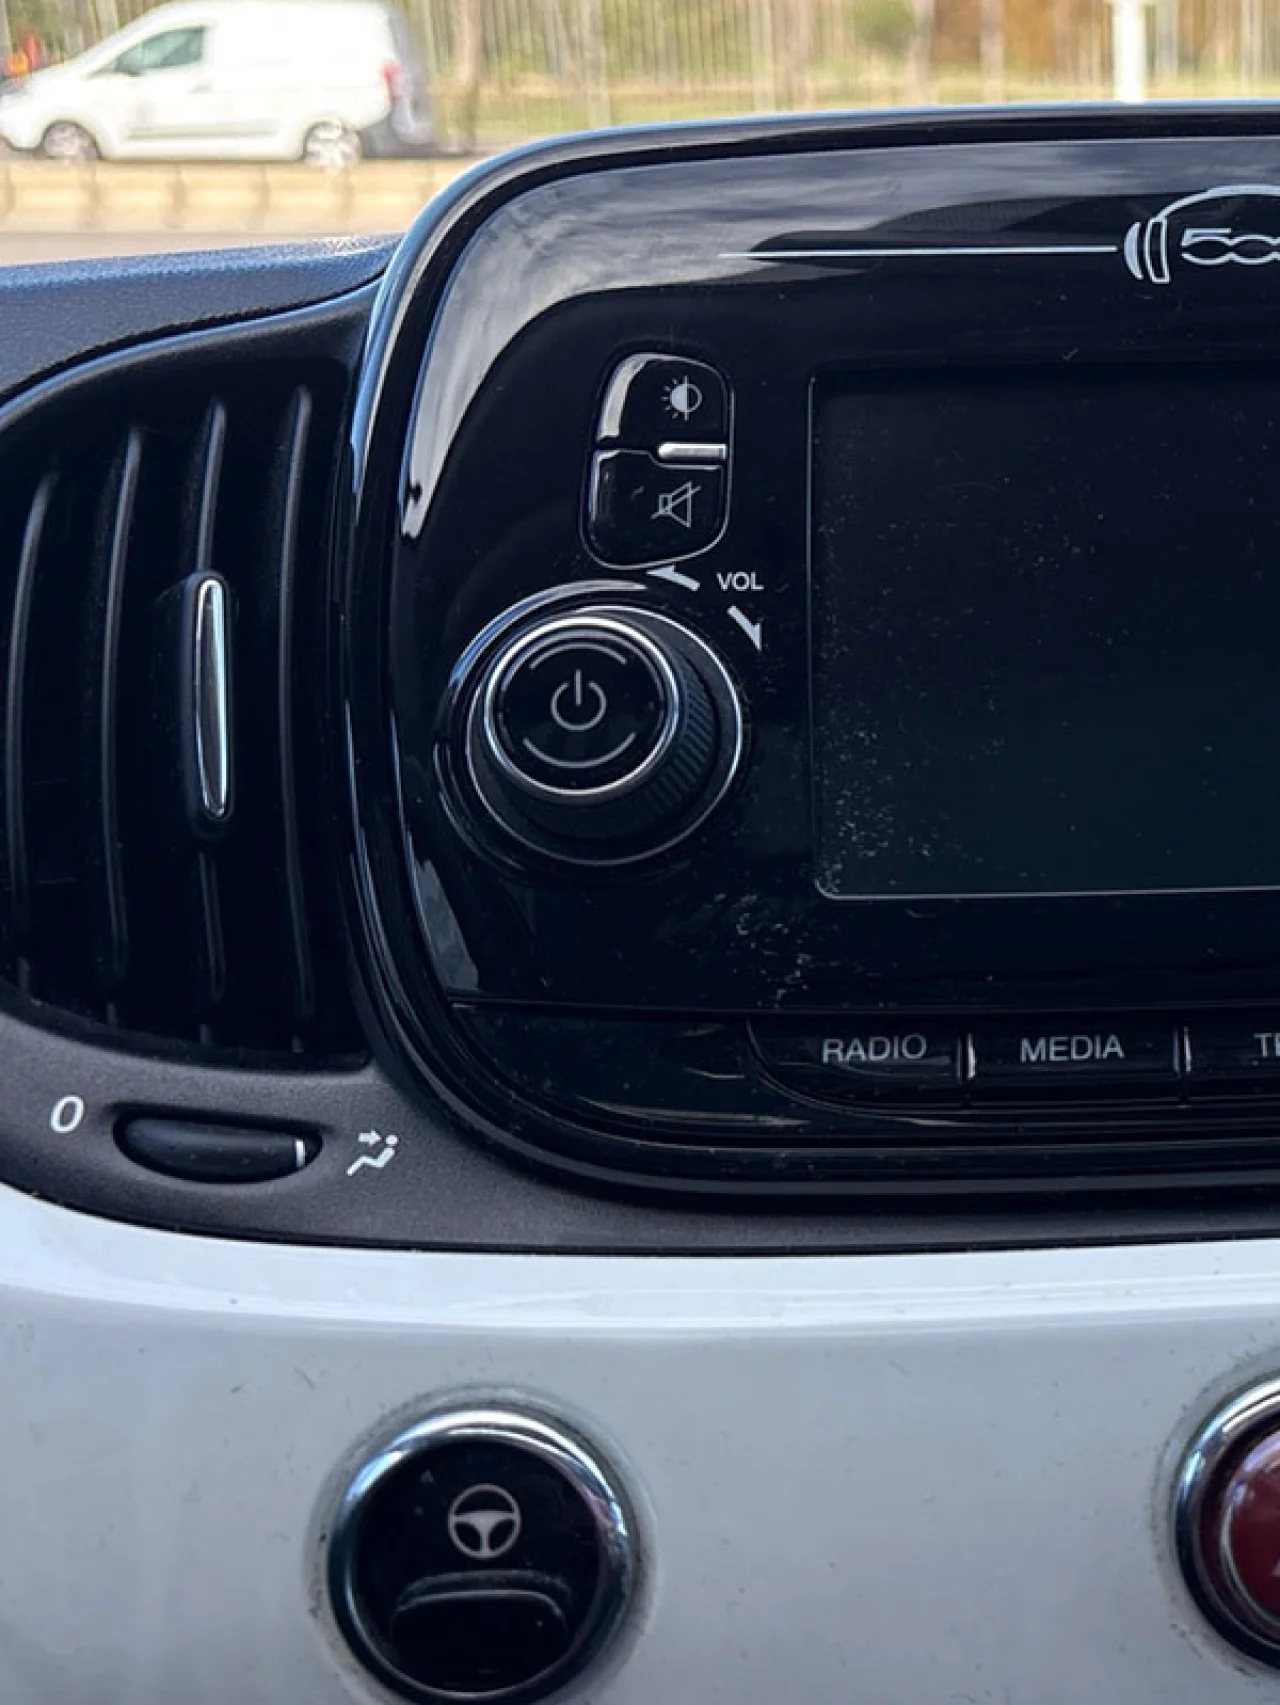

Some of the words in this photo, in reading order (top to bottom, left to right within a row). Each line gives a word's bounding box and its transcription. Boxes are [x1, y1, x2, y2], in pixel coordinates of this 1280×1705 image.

[716, 572, 764, 591] VOL
[822, 1034, 927, 1063] RADIO
[1020, 1035, 1124, 1062] MEDIA
